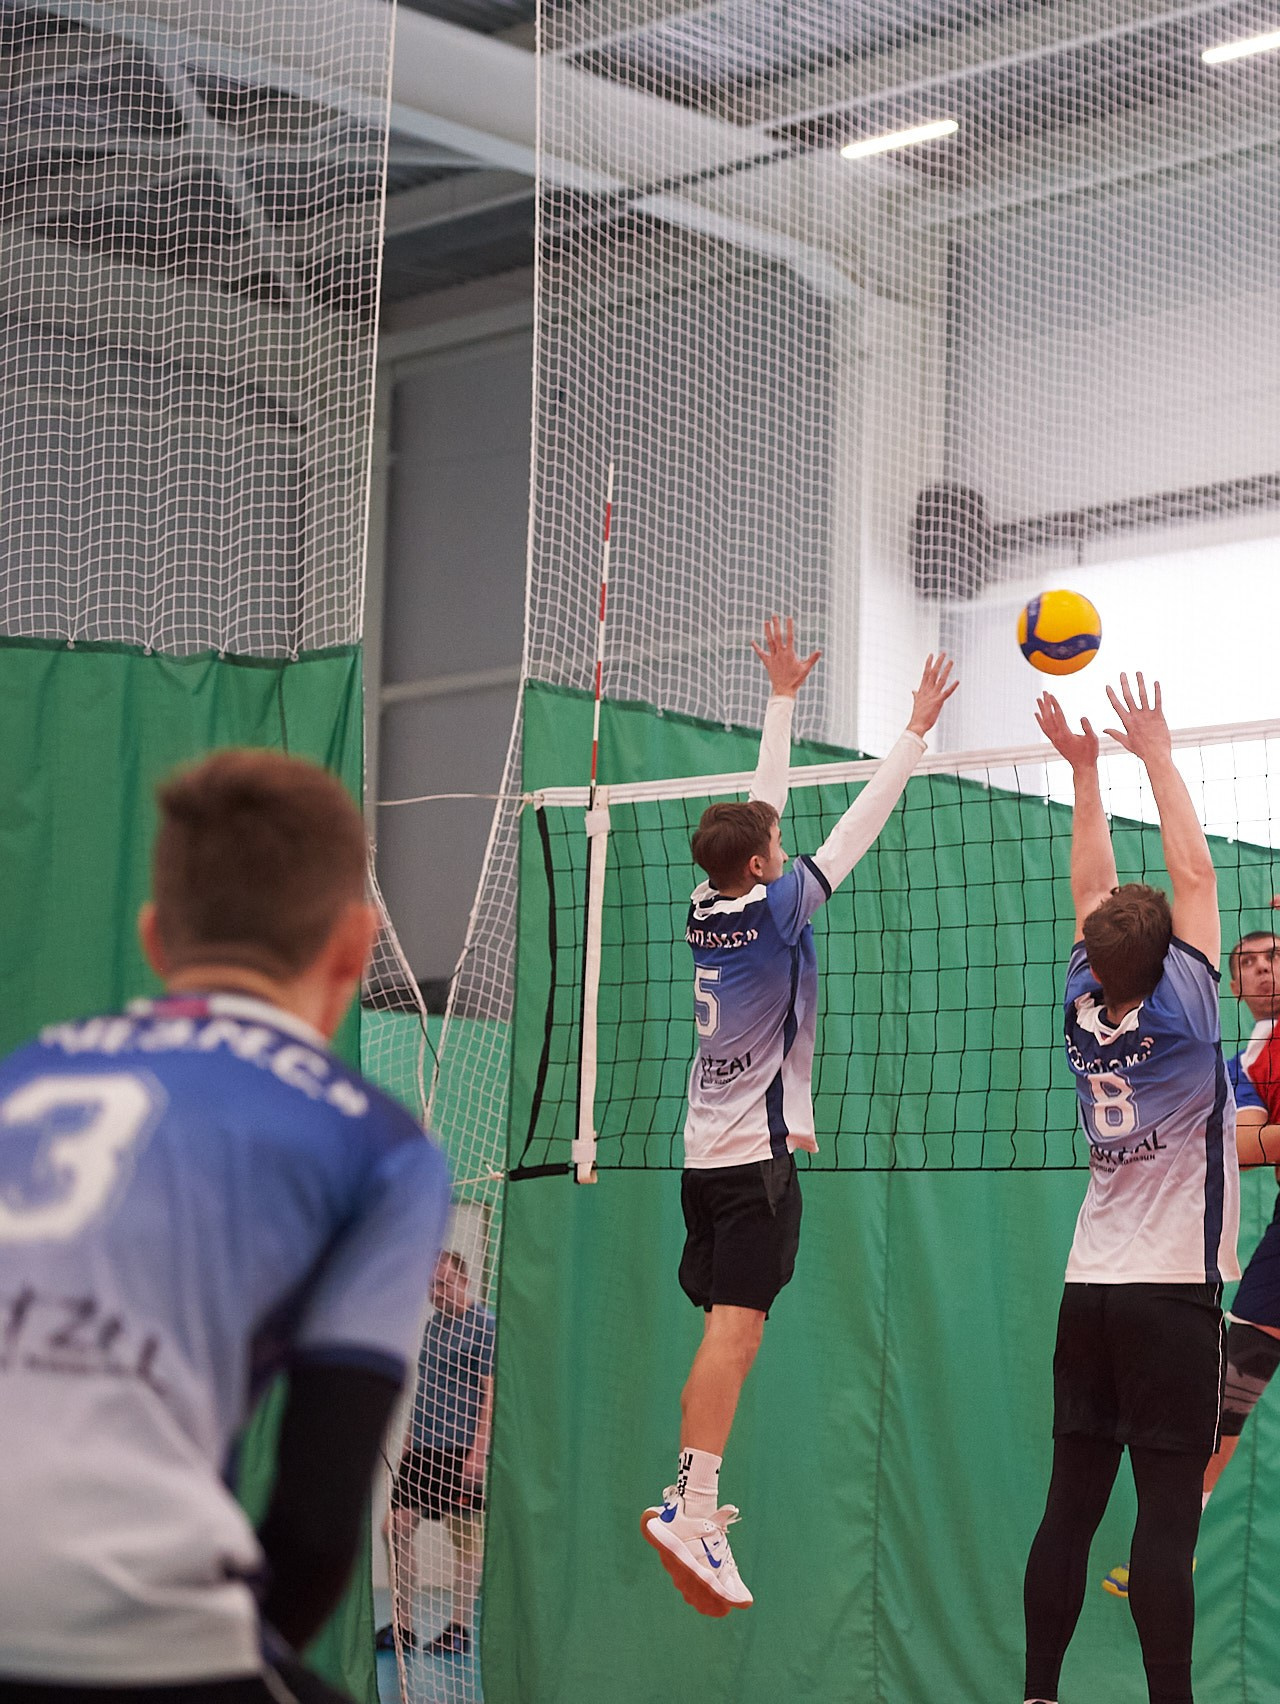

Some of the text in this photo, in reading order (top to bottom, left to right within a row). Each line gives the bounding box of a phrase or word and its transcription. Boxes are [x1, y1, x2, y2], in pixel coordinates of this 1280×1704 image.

[694, 964, 721, 1039] 5
[1086, 1072, 1138, 1139] 8
[0, 1073, 158, 1244] 3
